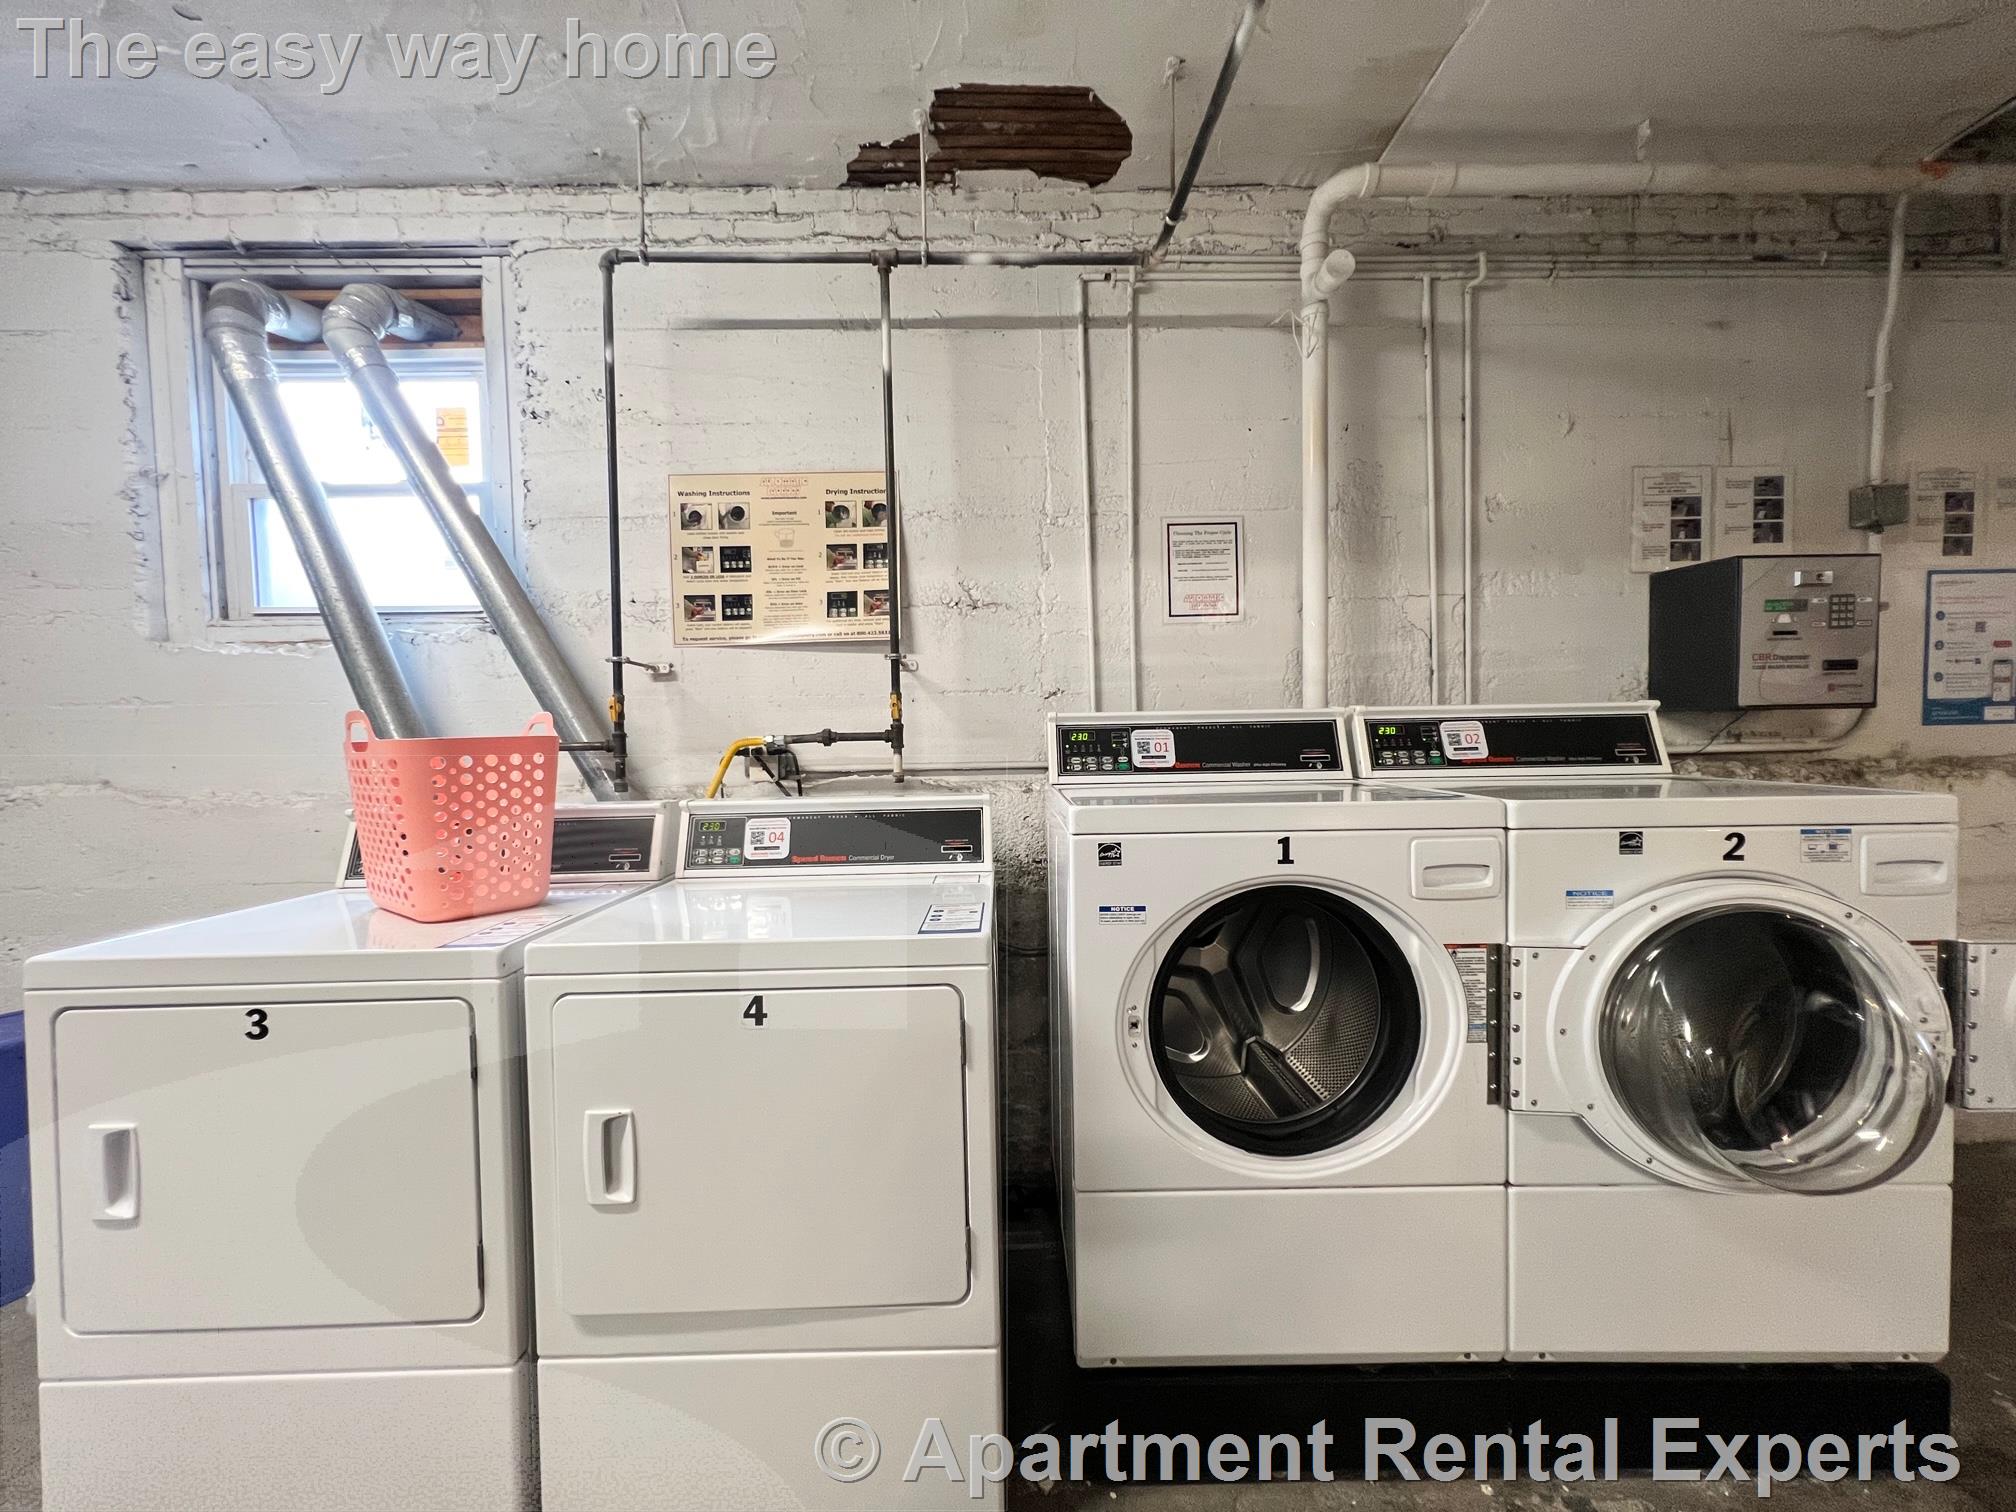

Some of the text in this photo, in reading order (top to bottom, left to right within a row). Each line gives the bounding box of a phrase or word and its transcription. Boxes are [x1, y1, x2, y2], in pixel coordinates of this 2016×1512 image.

[677, 489, 751, 498] Washing Instructions
[825, 488, 848, 496] Drying
[1071, 732, 1089, 741] 230
[1378, 726, 1397, 735] 230
[1464, 733, 1481, 745] 02
[1154, 741, 1170, 753] 01
[703, 822, 721, 831] 230
[768, 831, 785, 844] 04
[1277, 836, 1295, 865] 1
[1723, 832, 1746, 861] 2
[880, 854, 895, 862] Dryer
[743, 996, 768, 1026] 4
[244, 1008, 270, 1040] 3
